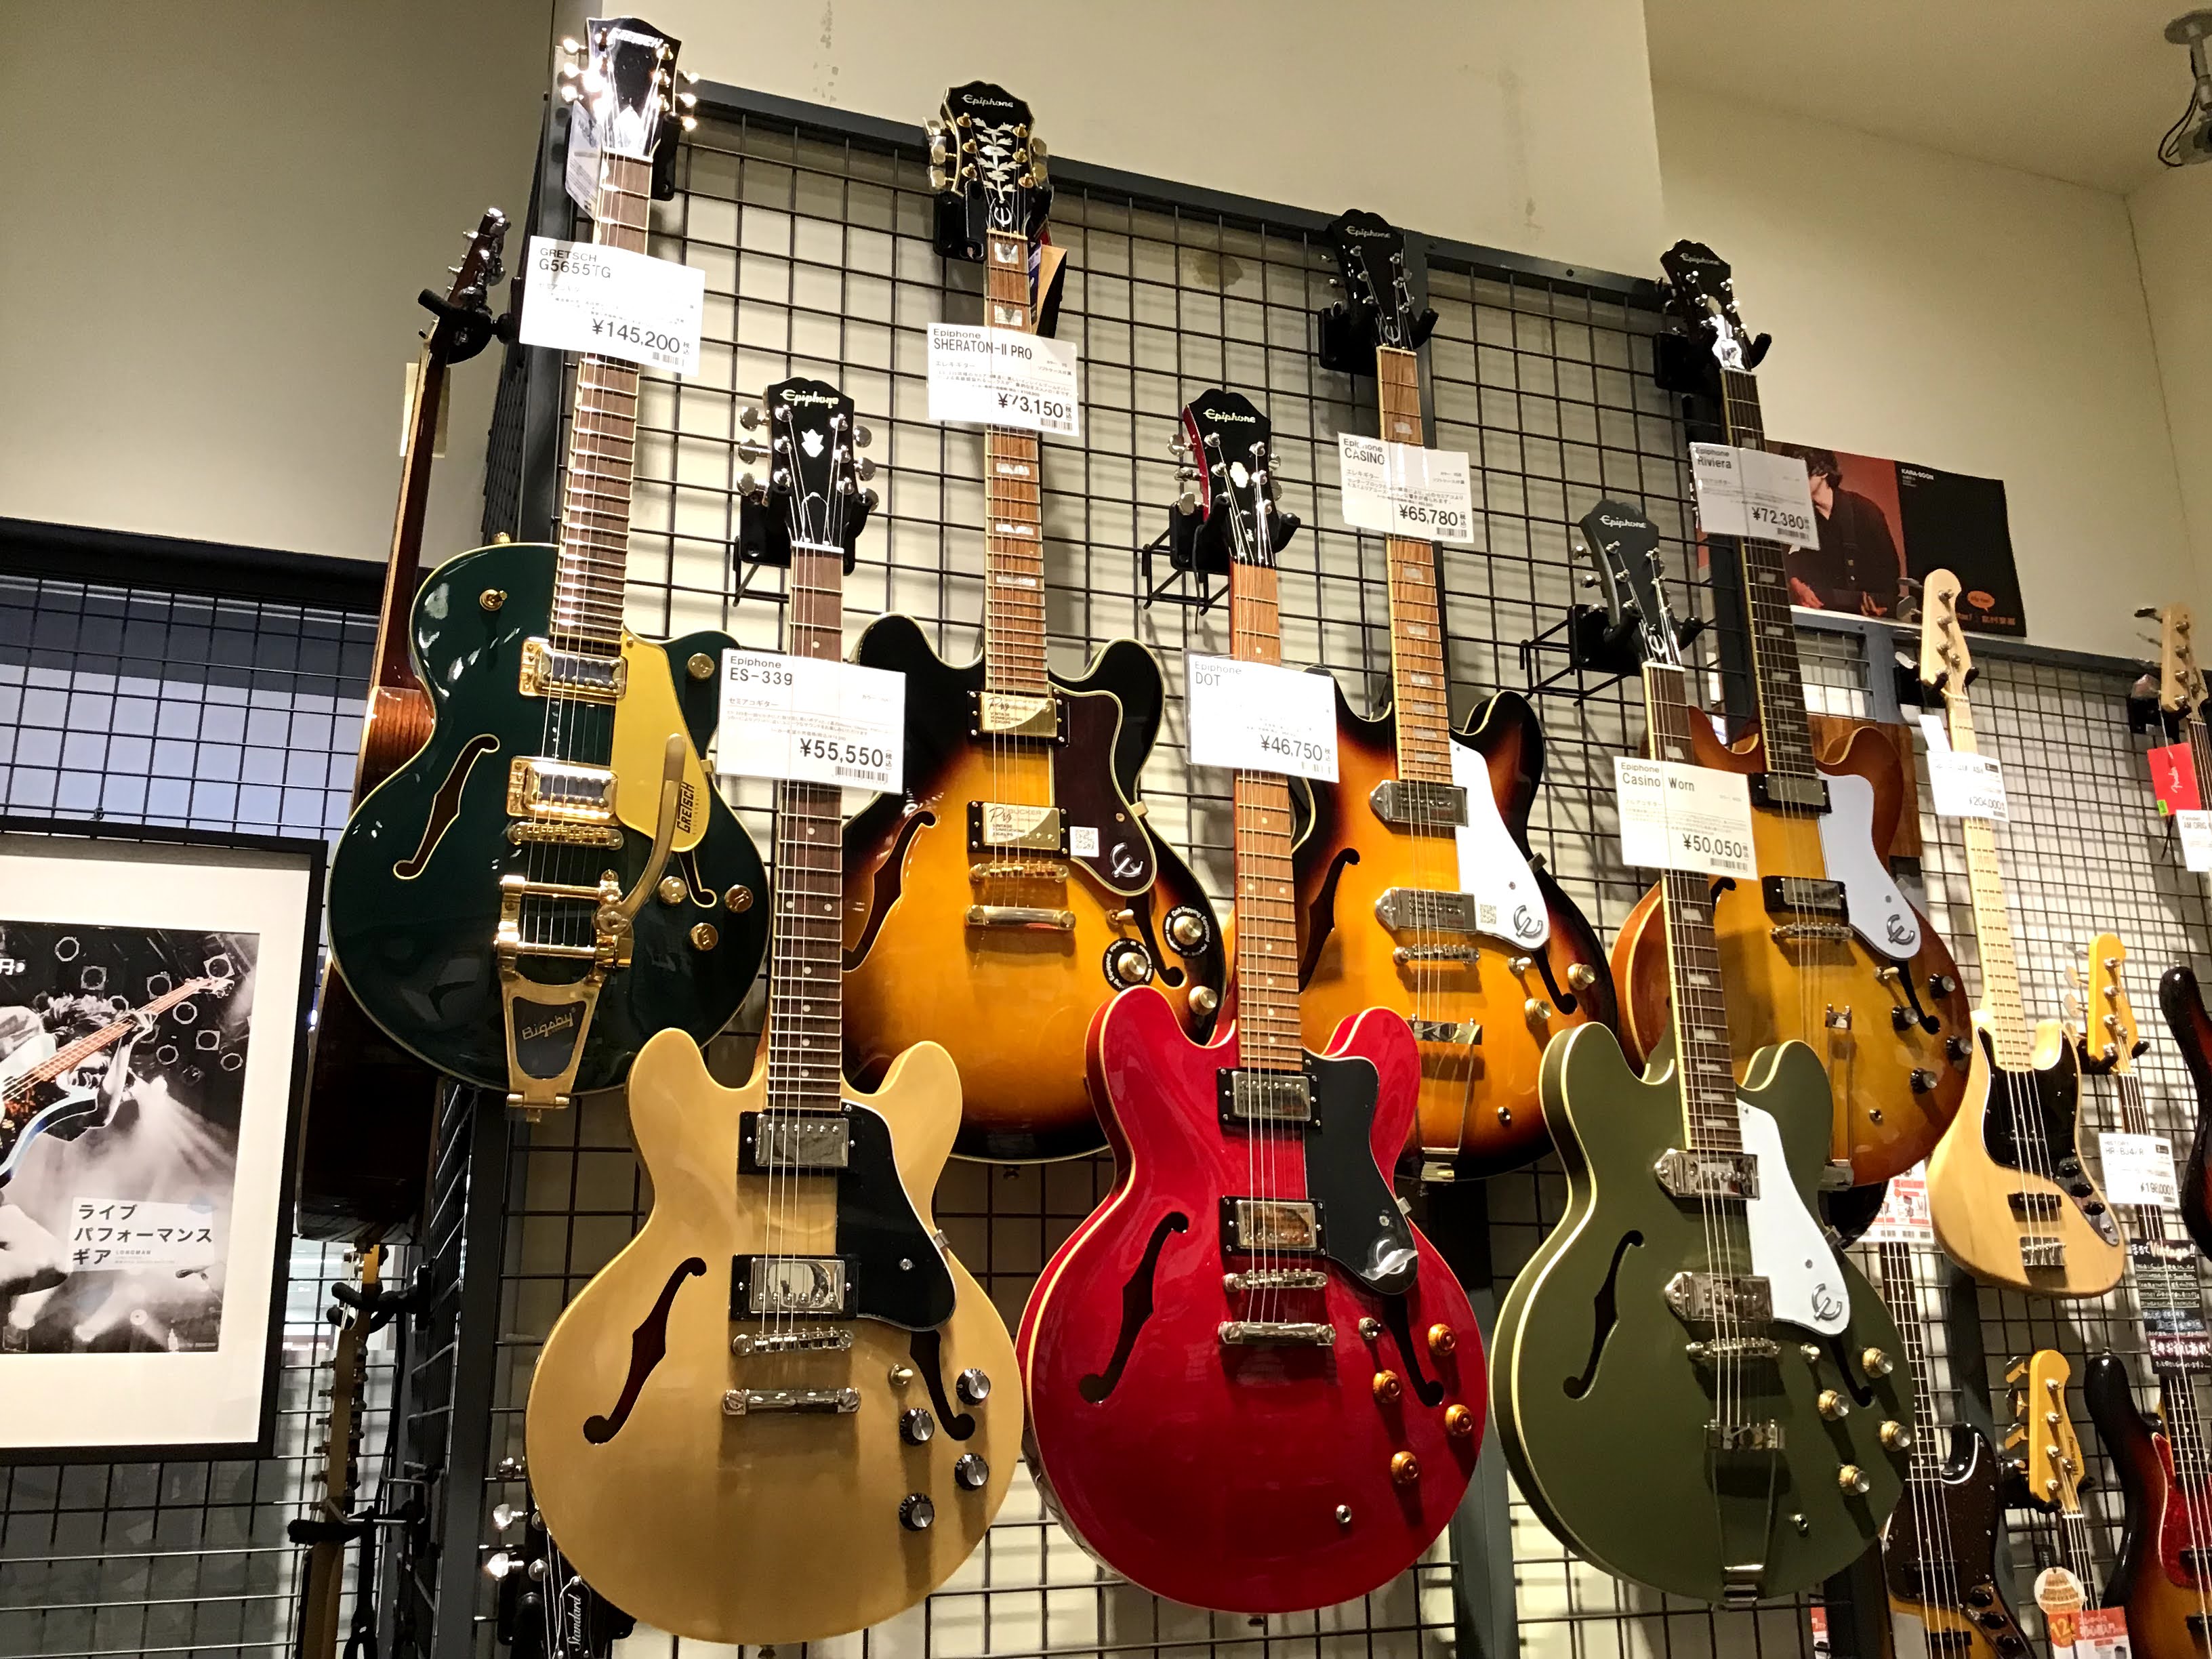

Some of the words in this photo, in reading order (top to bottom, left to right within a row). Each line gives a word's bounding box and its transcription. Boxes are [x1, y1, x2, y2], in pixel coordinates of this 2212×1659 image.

[962, 94, 1014, 108] Epiphone
[1345, 226, 1391, 238] Epiphone
[540, 247, 596, 262] GRETSCH
[539, 259, 611, 279] G5655TG
[592, 318, 680, 353] ¥145,200
[933, 328, 981, 340] Epiphone
[934, 337, 1007, 356] SHERATON-II
[1010, 344, 1033, 360] PRO
[780, 389, 839, 409] Epiphone
[998, 392, 1063, 418] ¥73,150
[1203, 409, 1256, 424] Epiphone
[1343, 438, 1383, 453] Epione
[1697, 455, 1732, 469] Riviera
[1399, 504, 1458, 527] ¥65,780
[1599, 514, 1647, 529] Epiphone
[730, 655, 782, 669] Epiphone
[1195, 661, 1242, 675] Epiphone
[729, 668, 793, 686] ES-339
[1195, 671, 1221, 687] DOT
[729, 697, 779, 708] セミアコギター
[800, 737, 884, 768] ¥55,550
[1260, 734, 1323, 761] ¥46,750
[1620, 762, 1660, 773] Epiphone
[1622, 773, 1661, 787] Casino
[1668, 777, 1695, 792] Worn
[677, 781, 695, 834] GRETSCH
[988, 806, 1012, 823] Pro
[1682, 833, 1742, 859] ¥50,050
[521, 1012, 575, 1041] Bigsby
[79, 1204, 138, 1221] ライブ
[73, 1227, 213, 1244] パフォーマンス
[73, 1248, 112, 1266] ギア
[567, 1593, 582, 1652] Standard
